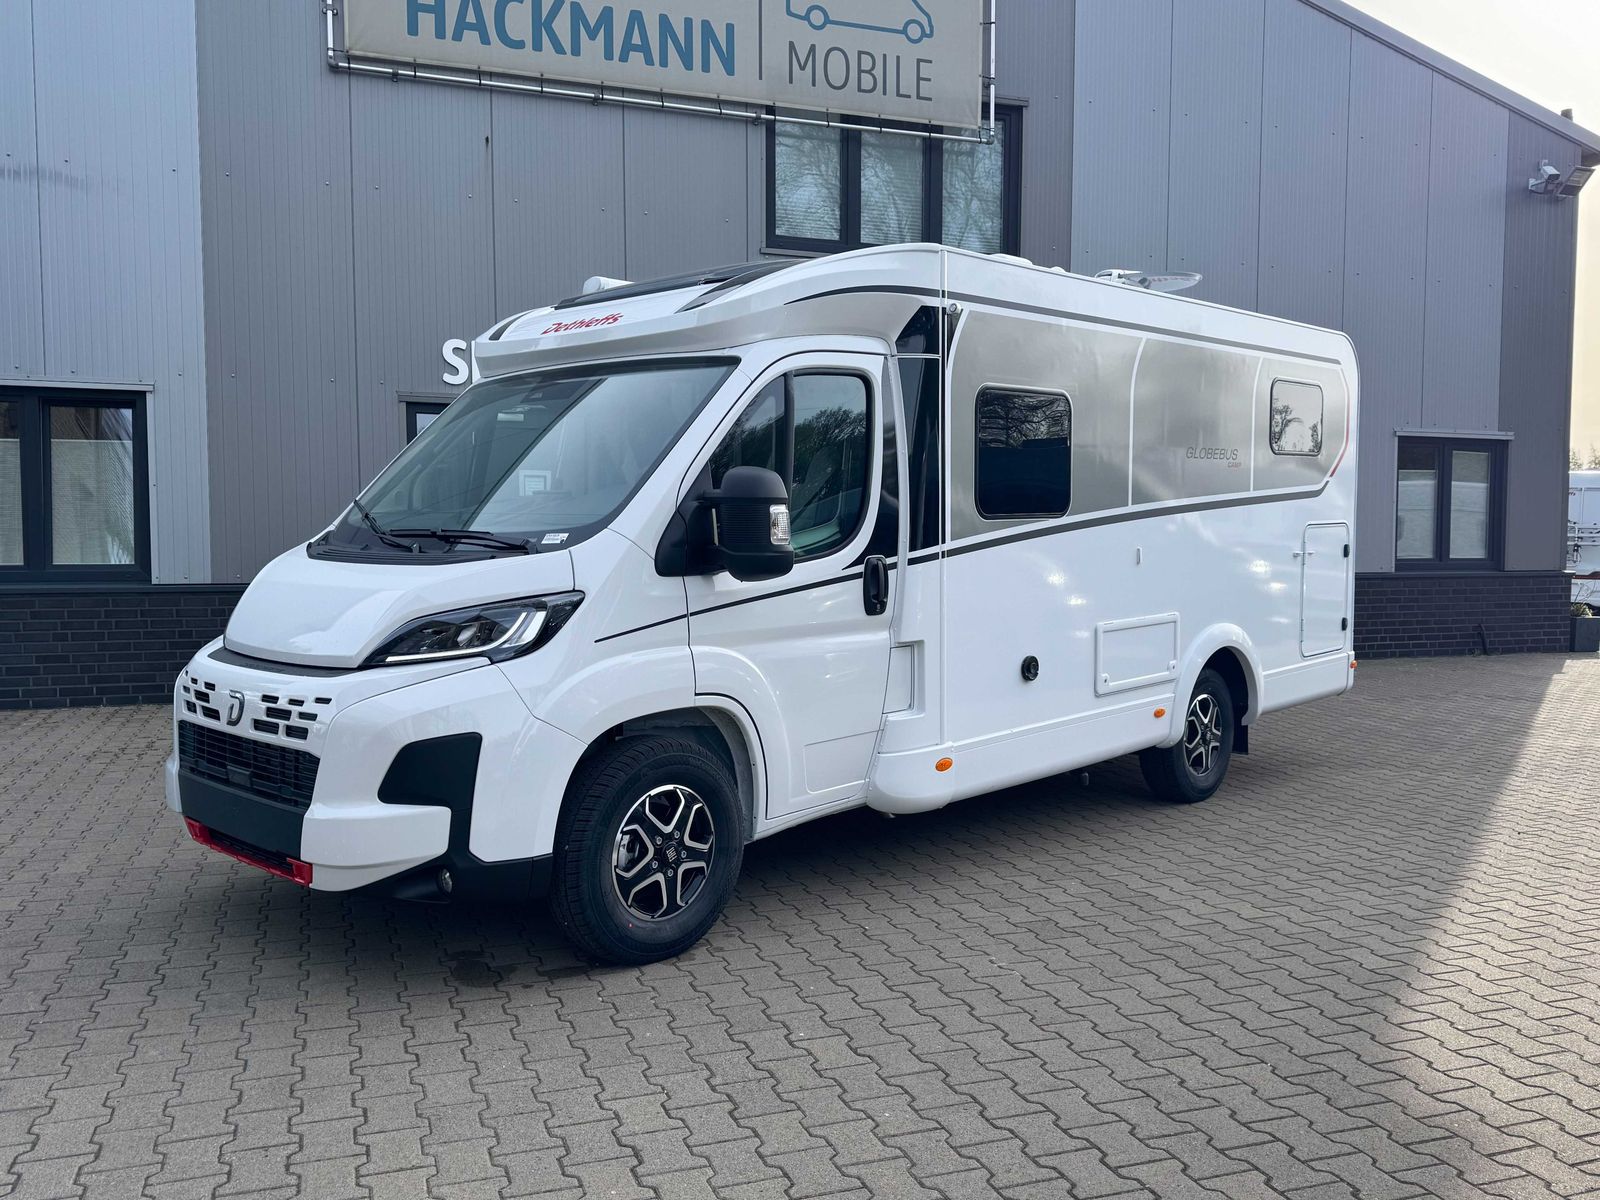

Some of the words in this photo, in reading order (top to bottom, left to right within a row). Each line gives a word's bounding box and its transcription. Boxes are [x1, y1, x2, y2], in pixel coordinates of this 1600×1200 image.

[407, 0, 735, 76] HACKMANN
[788, 40, 933, 102] MOBILE
[540, 312, 624, 335] Dethleffs
[1185, 446, 1239, 460] GLOBEBUS
